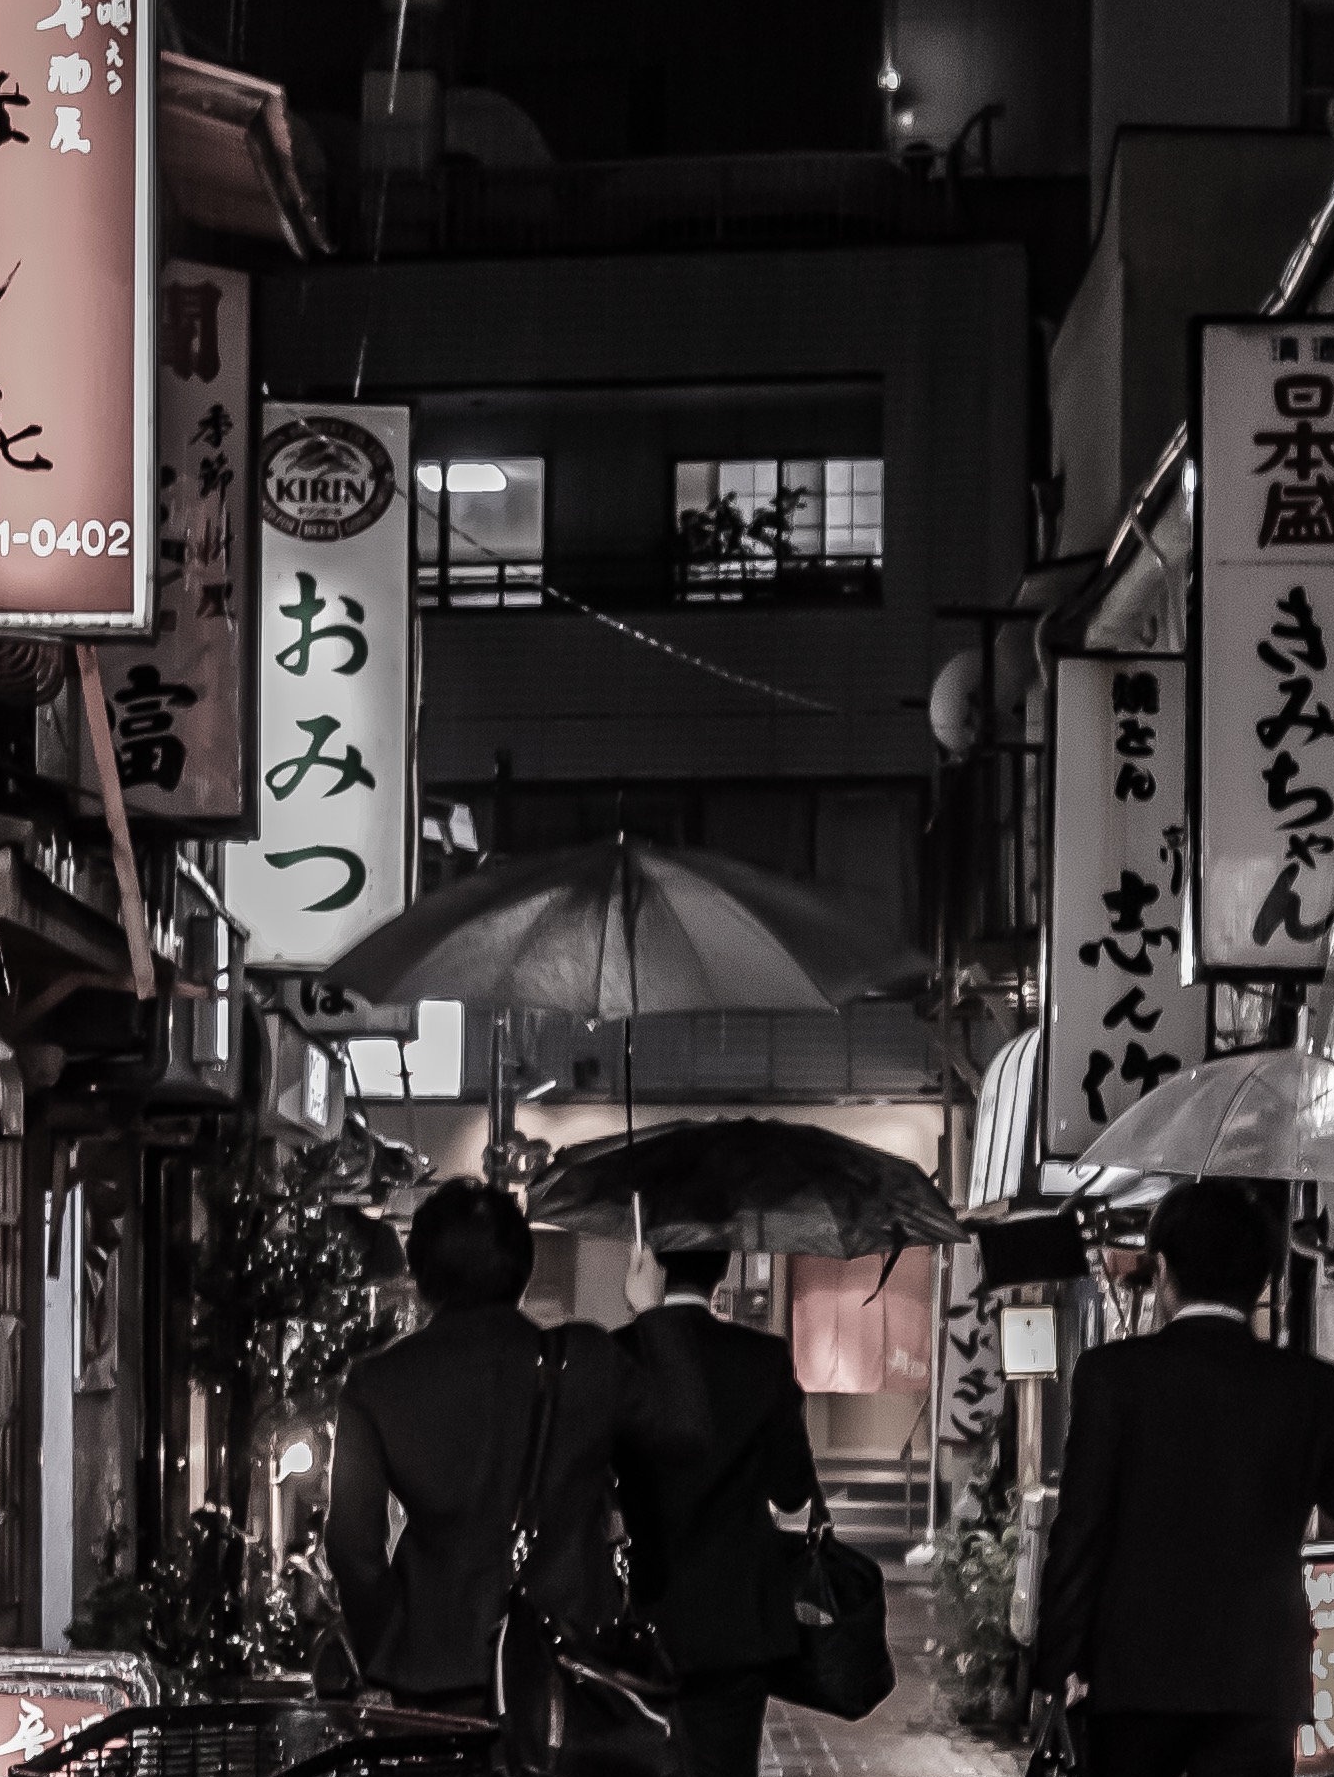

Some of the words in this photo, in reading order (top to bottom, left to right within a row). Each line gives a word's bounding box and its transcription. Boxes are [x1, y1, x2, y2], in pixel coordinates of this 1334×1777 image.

[275, 478, 366, 504] KIRIN
[265, 572, 375, 912] おみつ
